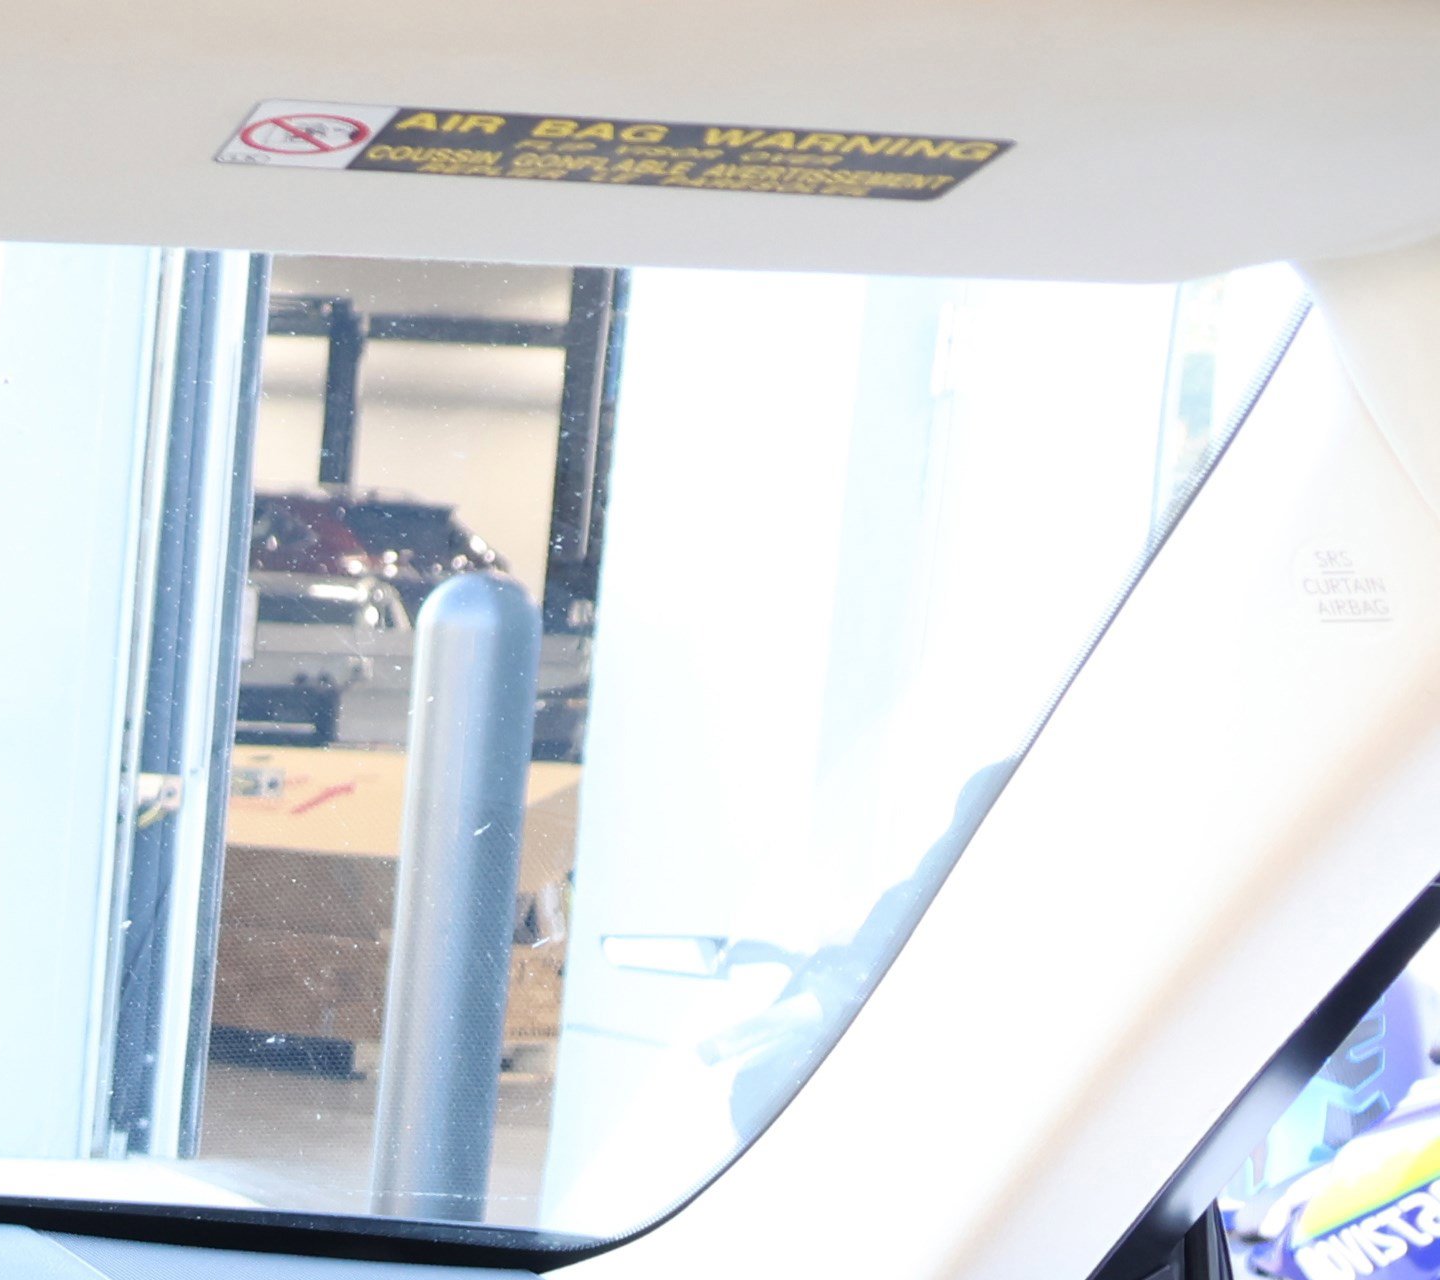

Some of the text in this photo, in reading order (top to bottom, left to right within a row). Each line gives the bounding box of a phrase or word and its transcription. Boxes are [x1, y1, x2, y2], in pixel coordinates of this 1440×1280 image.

[395, 111, 507, 136] AIR
[531, 118, 670, 144] BAG
[704, 127, 998, 161] WARNING
[1313, 550, 1355, 569] SRS
[1302, 577, 1387, 596] CURTAIN
[1317, 599, 1390, 617] AIRBAG
